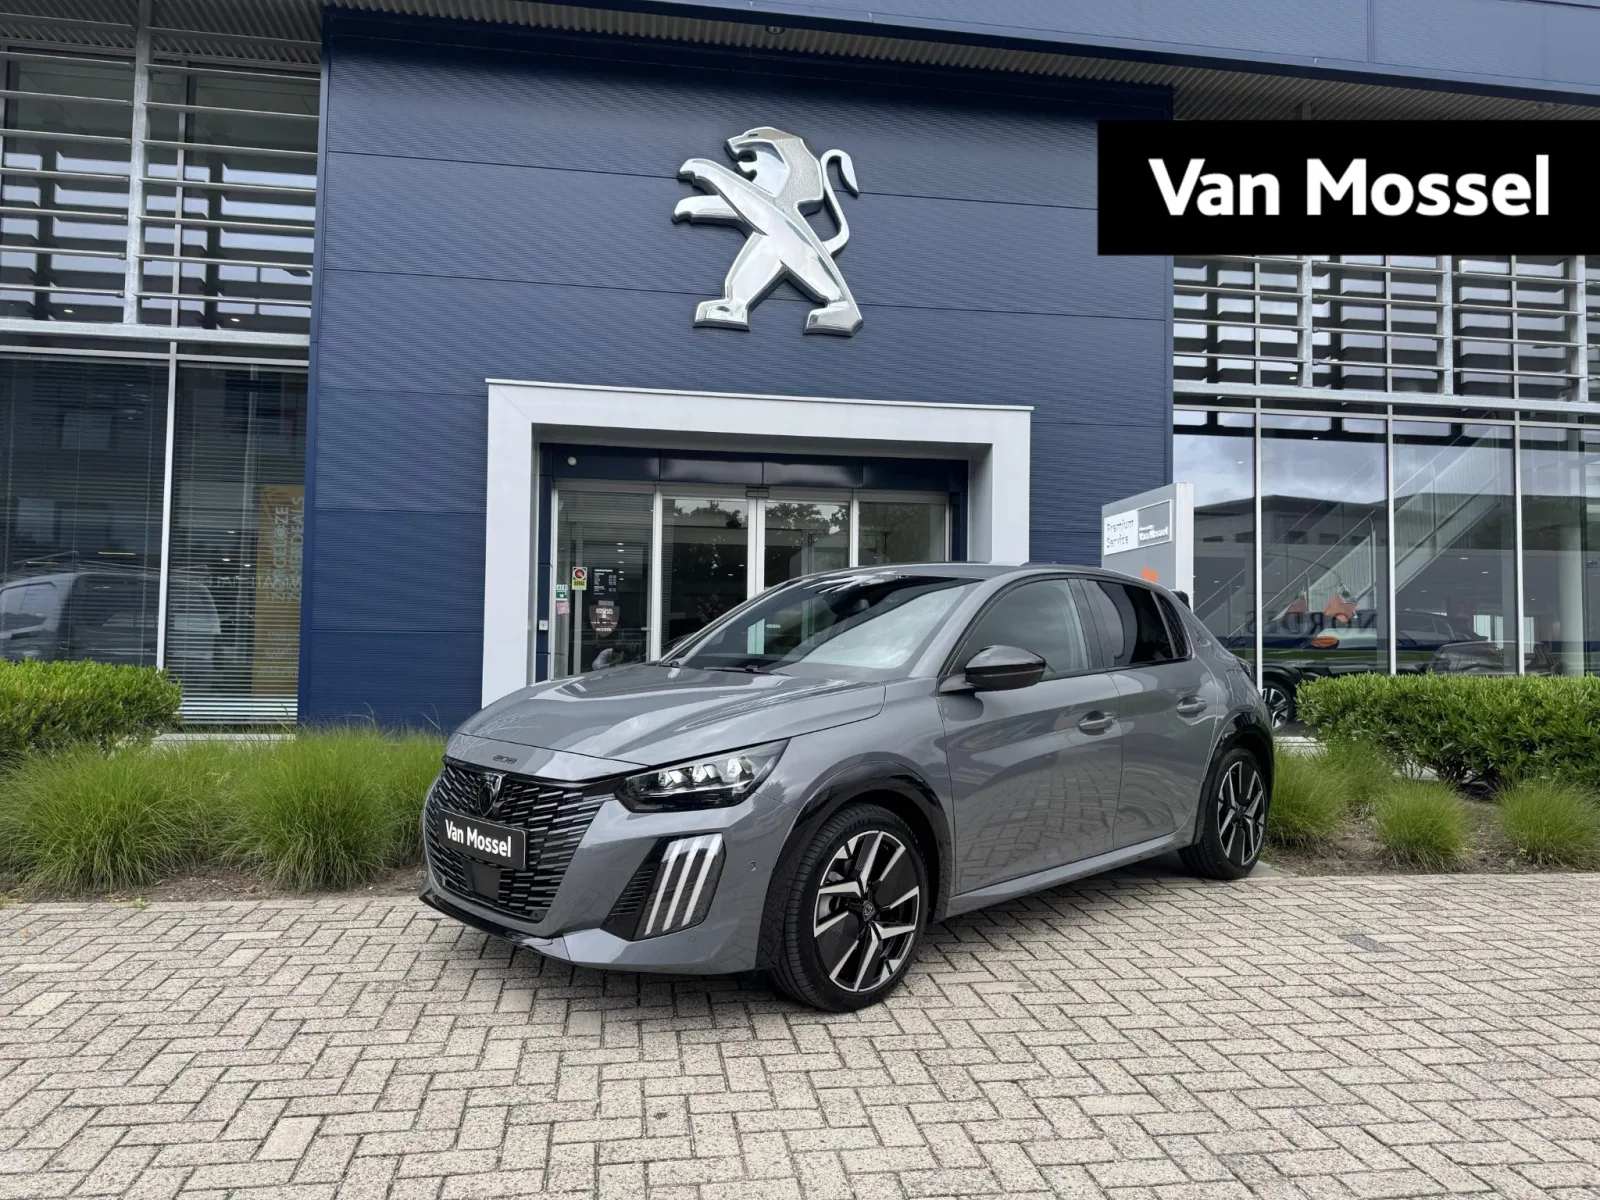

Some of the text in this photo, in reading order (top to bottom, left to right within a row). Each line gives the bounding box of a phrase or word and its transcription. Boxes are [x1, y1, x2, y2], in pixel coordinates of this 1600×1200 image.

[1106, 519, 1134, 533] Premium
[1106, 534, 1129, 548] Service
[445, 819, 512, 858] Van Mossel
